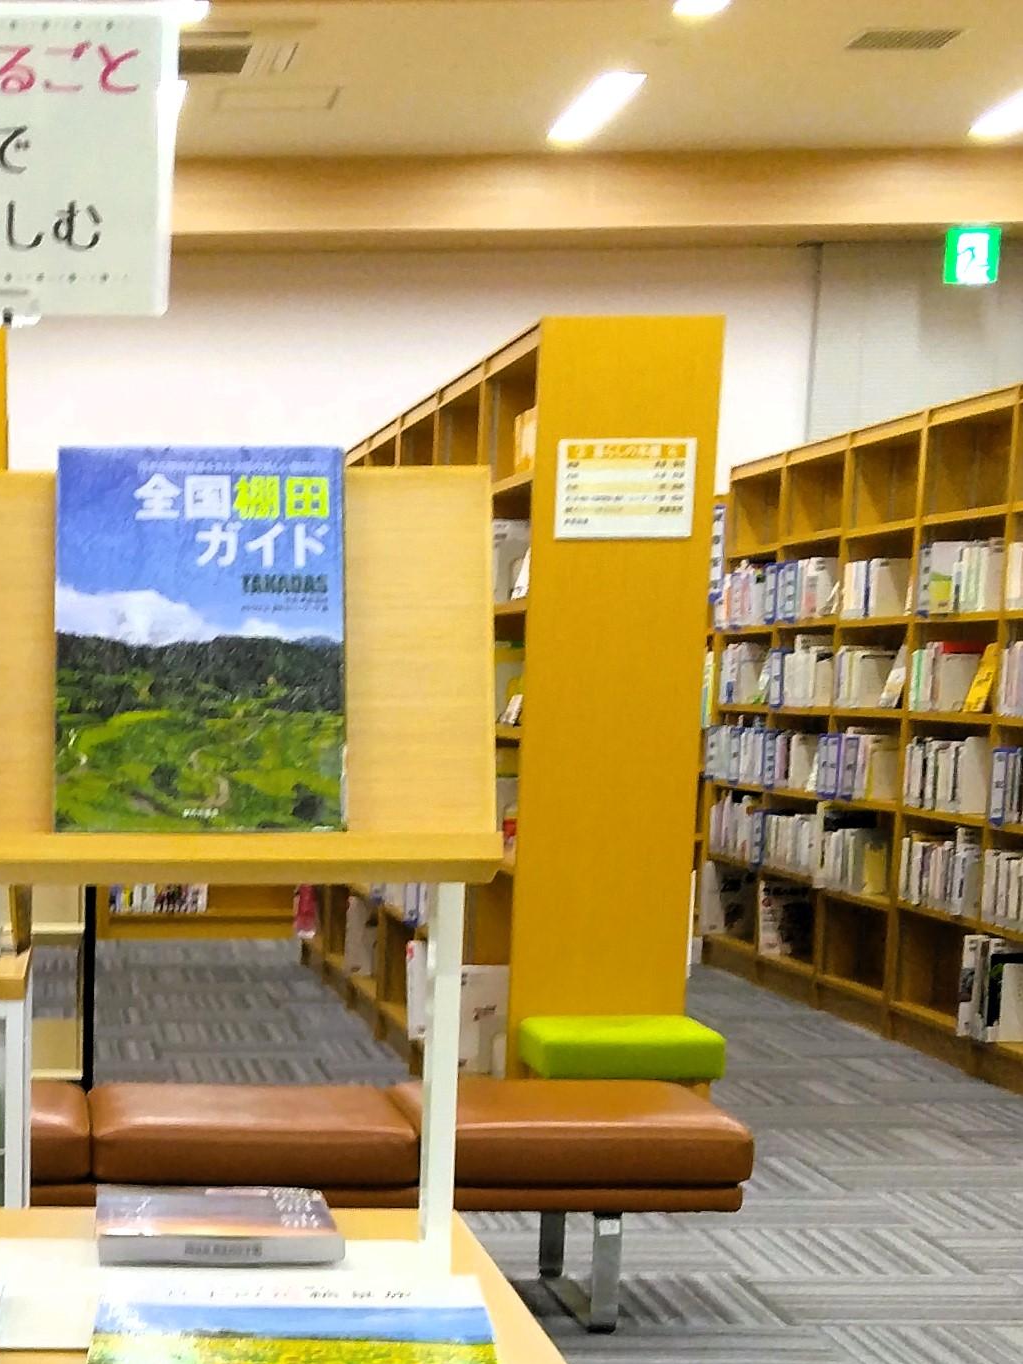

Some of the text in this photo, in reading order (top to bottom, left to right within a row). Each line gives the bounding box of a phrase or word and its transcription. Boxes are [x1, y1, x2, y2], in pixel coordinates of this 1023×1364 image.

[133, 472, 330, 521] 全国棚田
[195, 521, 331, 569] ガイド
